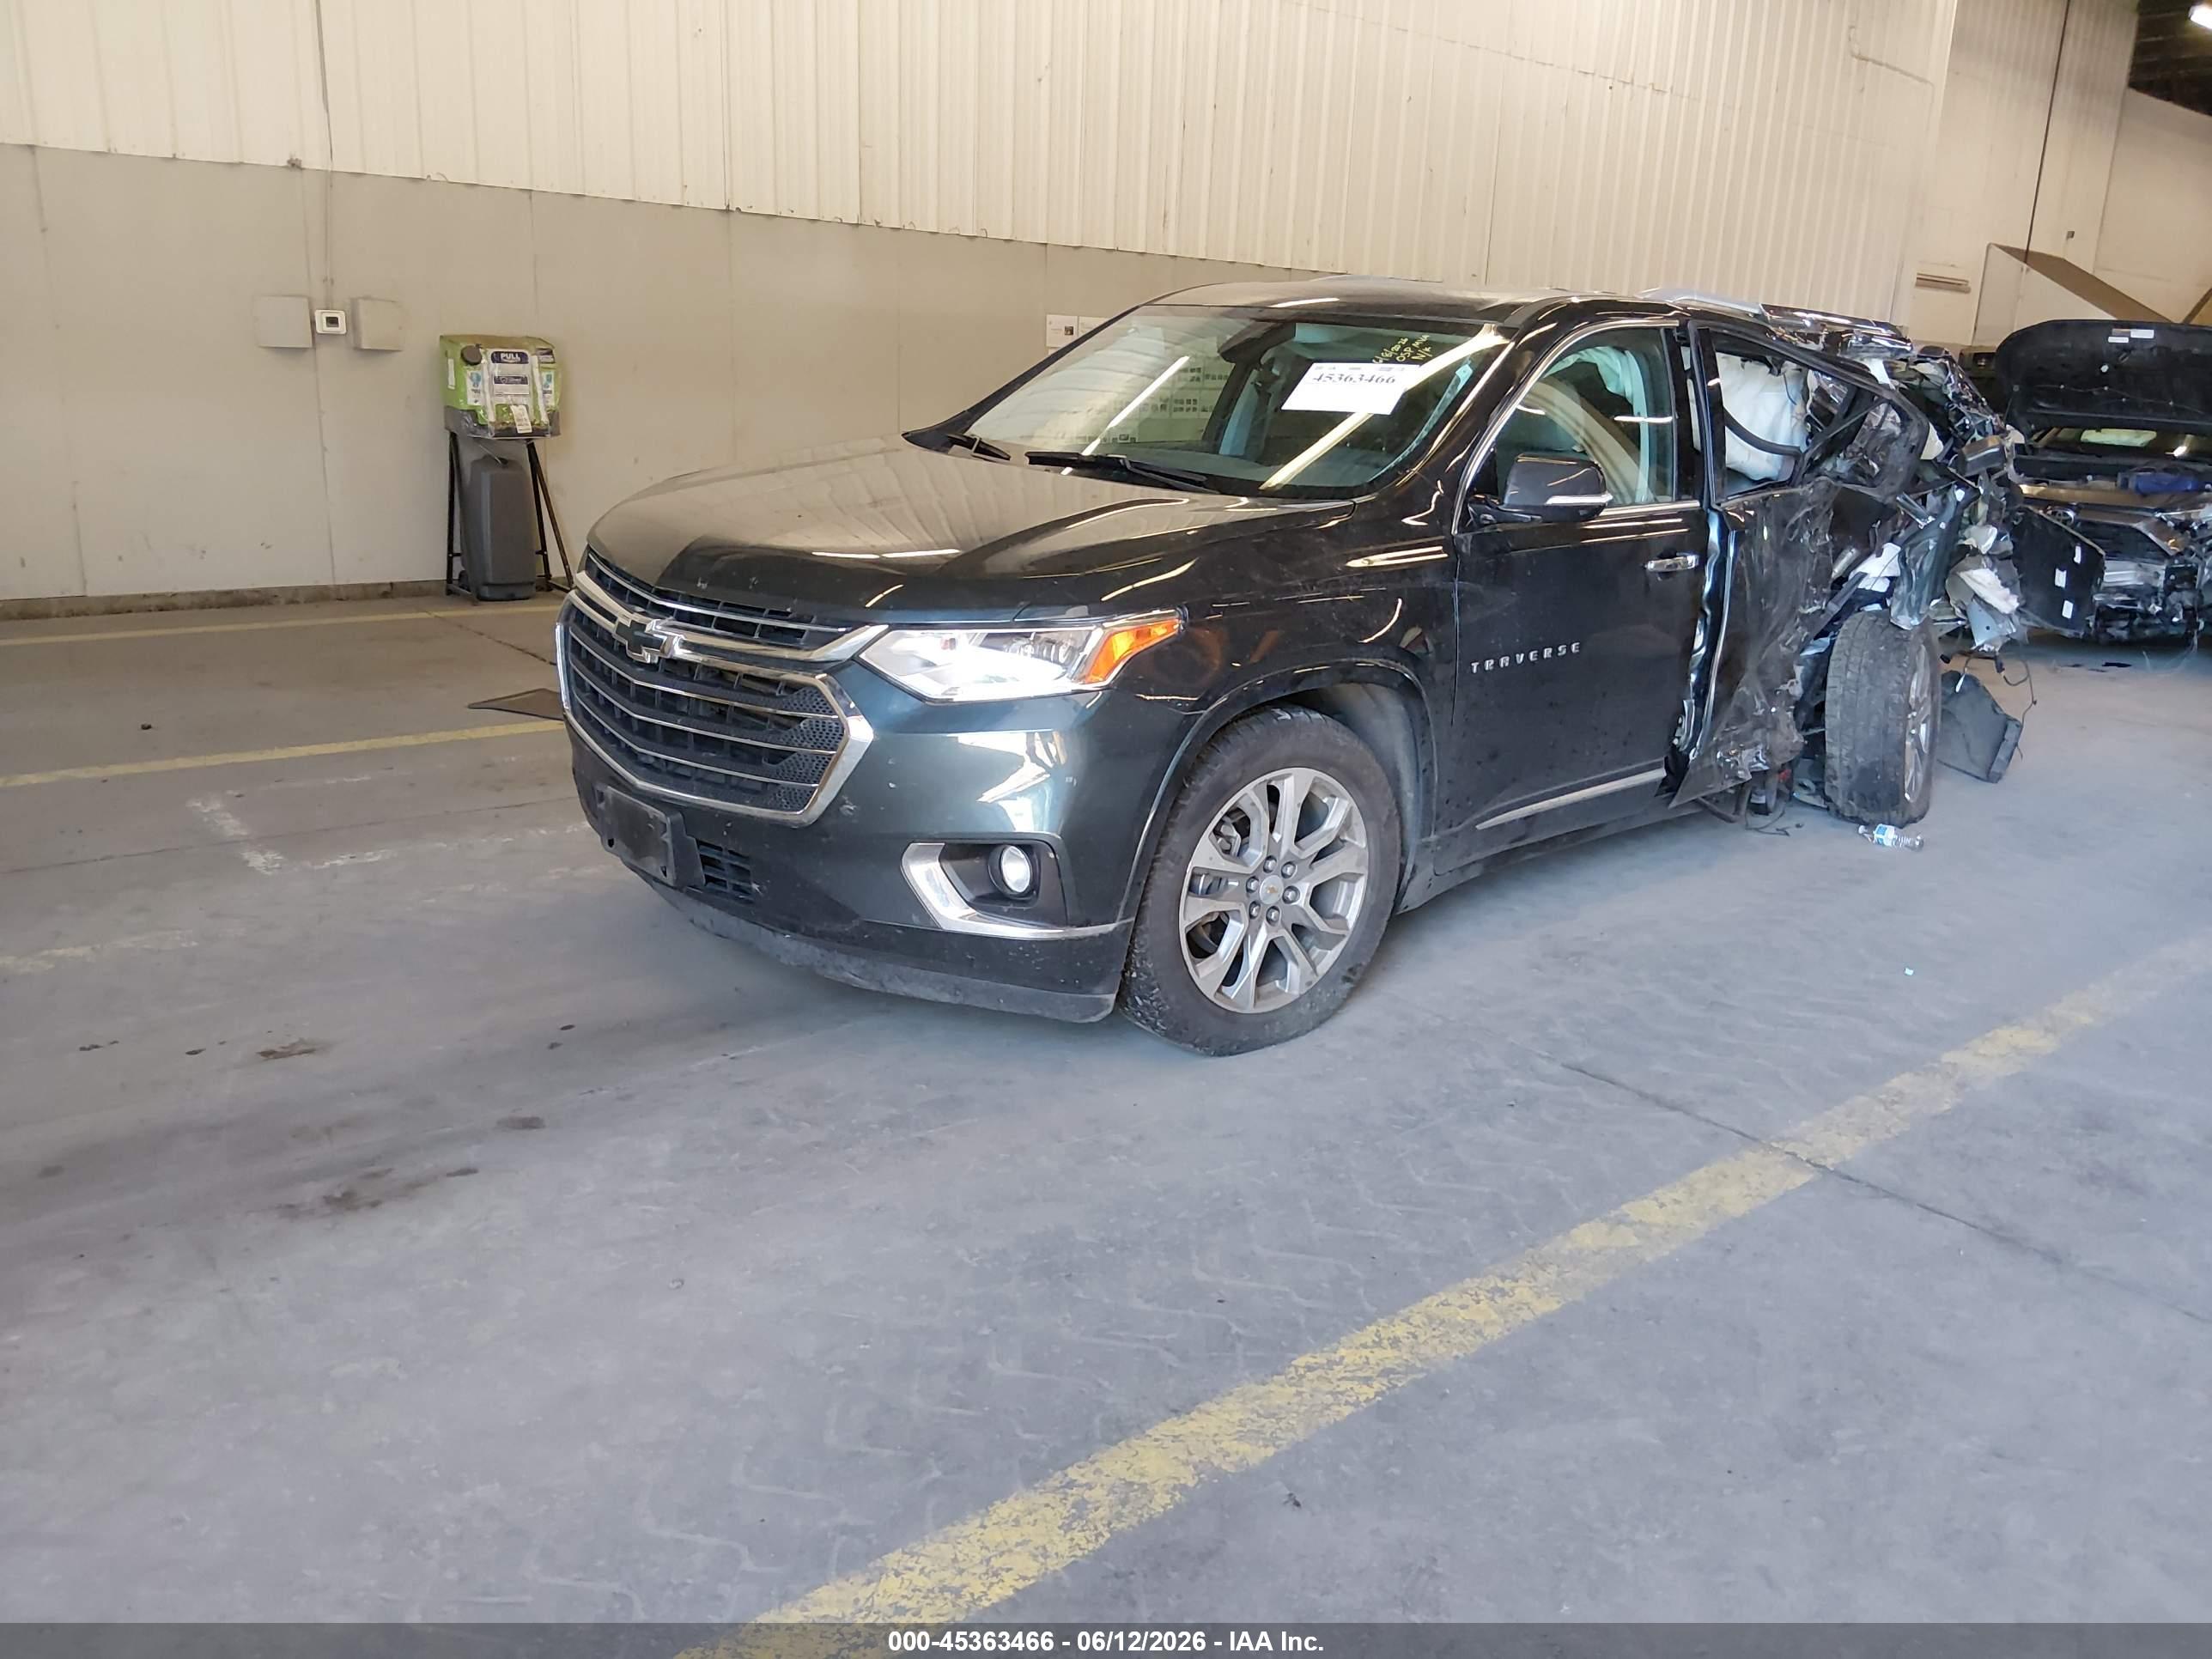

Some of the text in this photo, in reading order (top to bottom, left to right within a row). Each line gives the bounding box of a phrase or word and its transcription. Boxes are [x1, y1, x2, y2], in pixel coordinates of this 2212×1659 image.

[500, 352, 521, 362] PULL
[1312, 373, 1395, 384] 45363466
[1471, 641, 1580, 674] TRAVERSE
